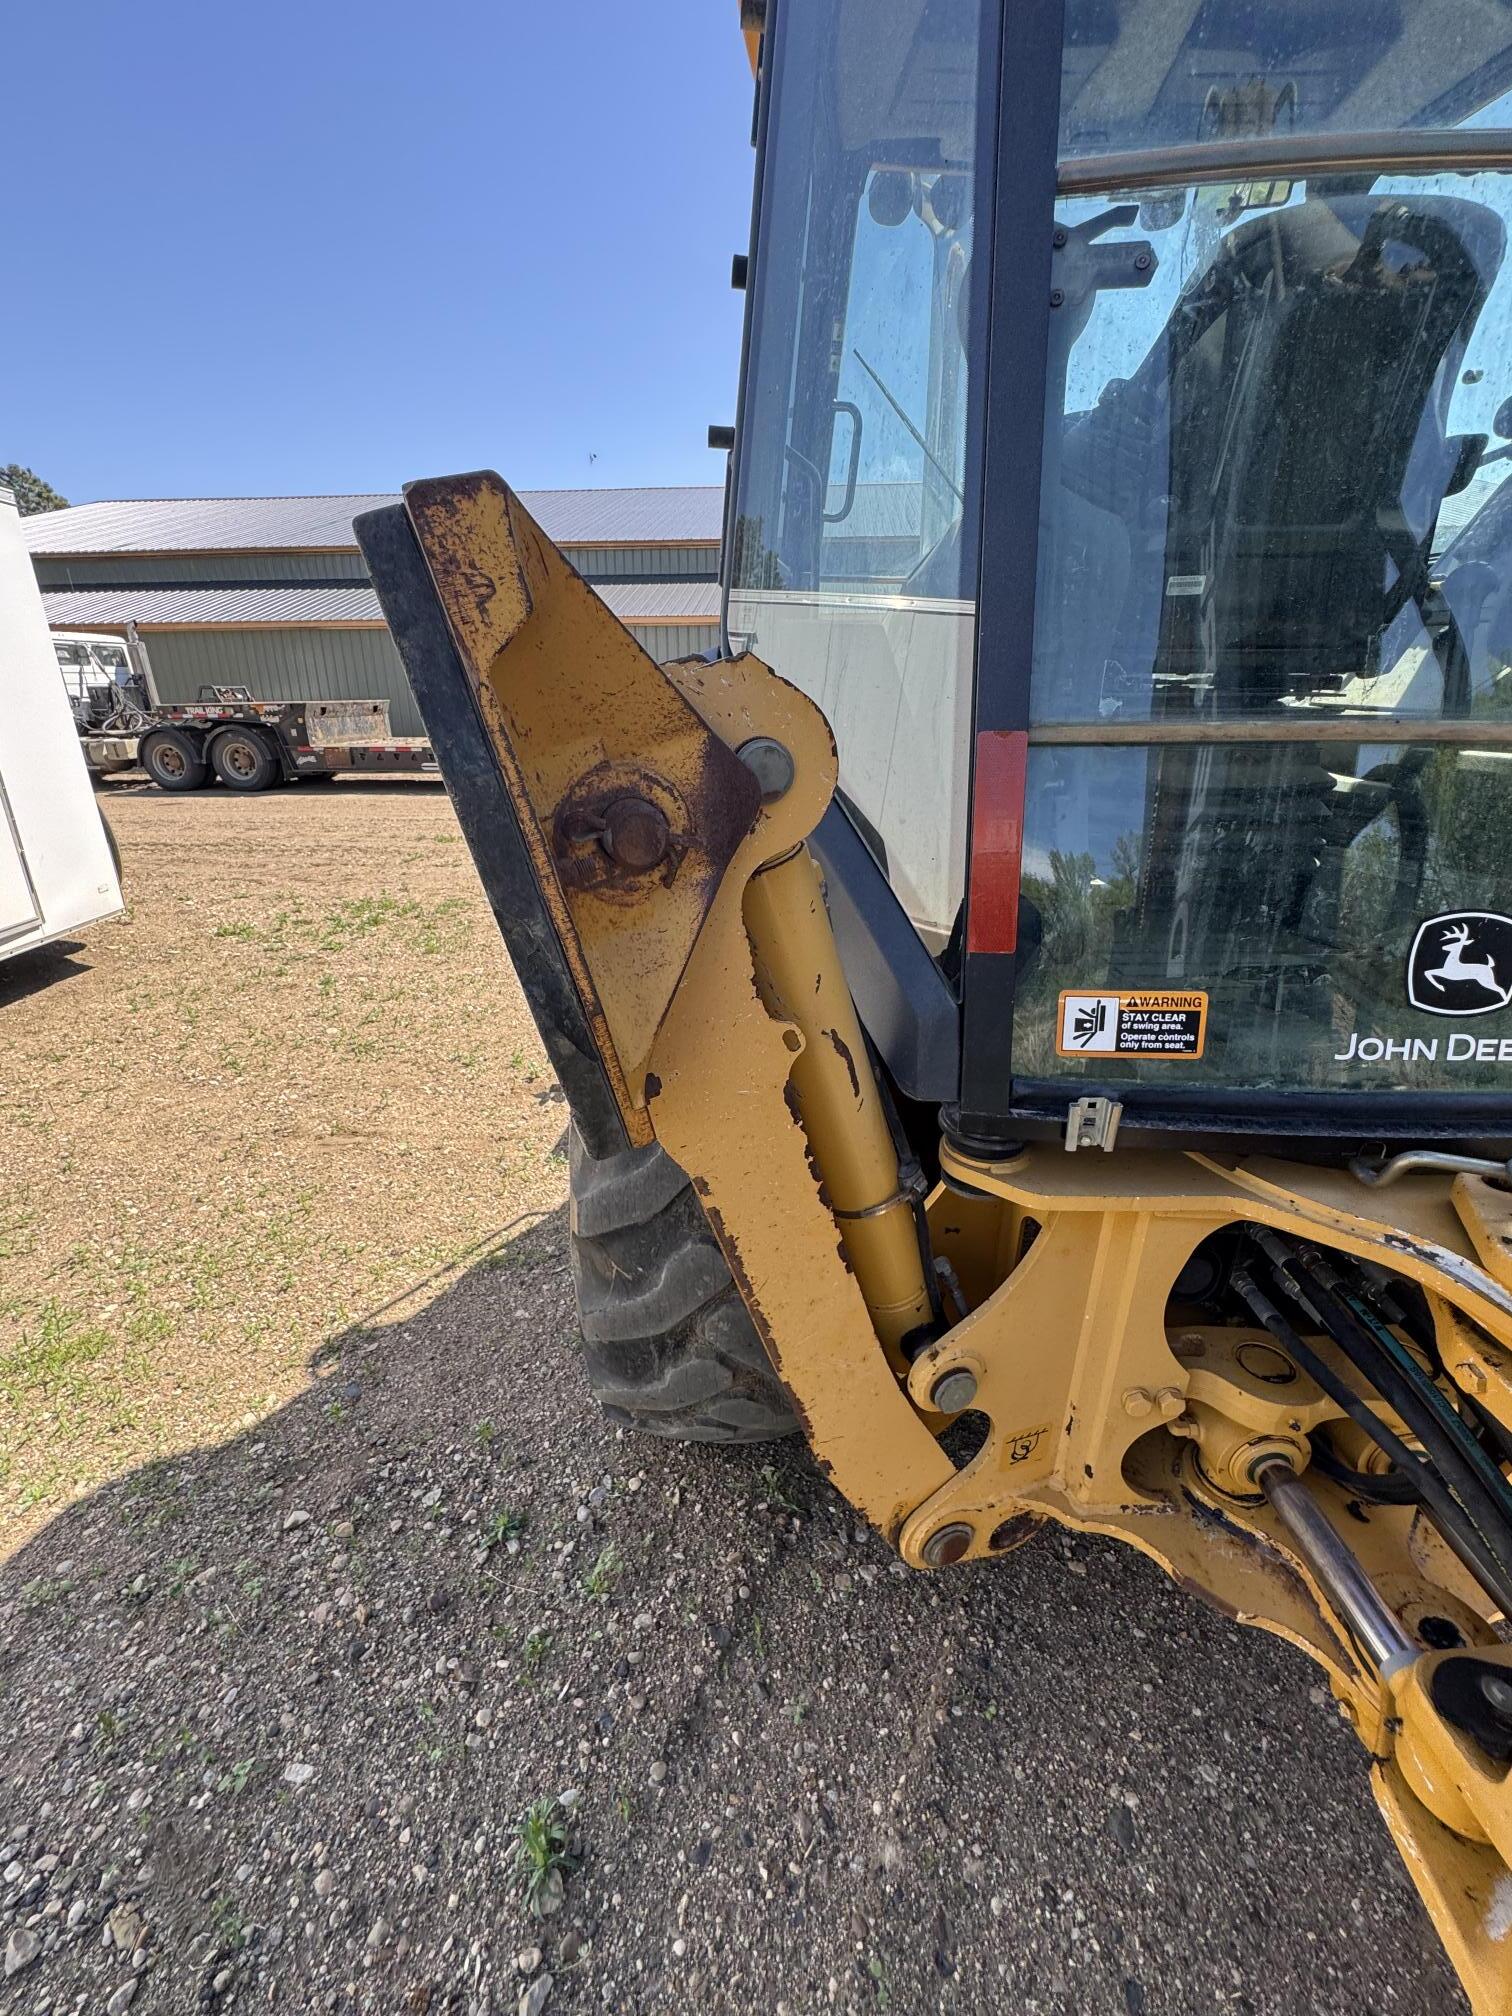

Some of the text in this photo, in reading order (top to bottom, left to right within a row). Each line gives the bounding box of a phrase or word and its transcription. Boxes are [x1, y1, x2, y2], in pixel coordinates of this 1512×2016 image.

[185, 706, 223, 714] TRAIL KING
[1139, 997, 1202, 1008] WARNING
[1122, 1014, 1187, 1022] STAY CLEAR
[1121, 1022, 1132, 1030] of
[1133, 1022, 1160, 1031] swing
[1121, 1033, 1156, 1042] Operate
[1120, 1041, 1139, 1050] only
[1334, 1033, 1438, 1061] JOHN
